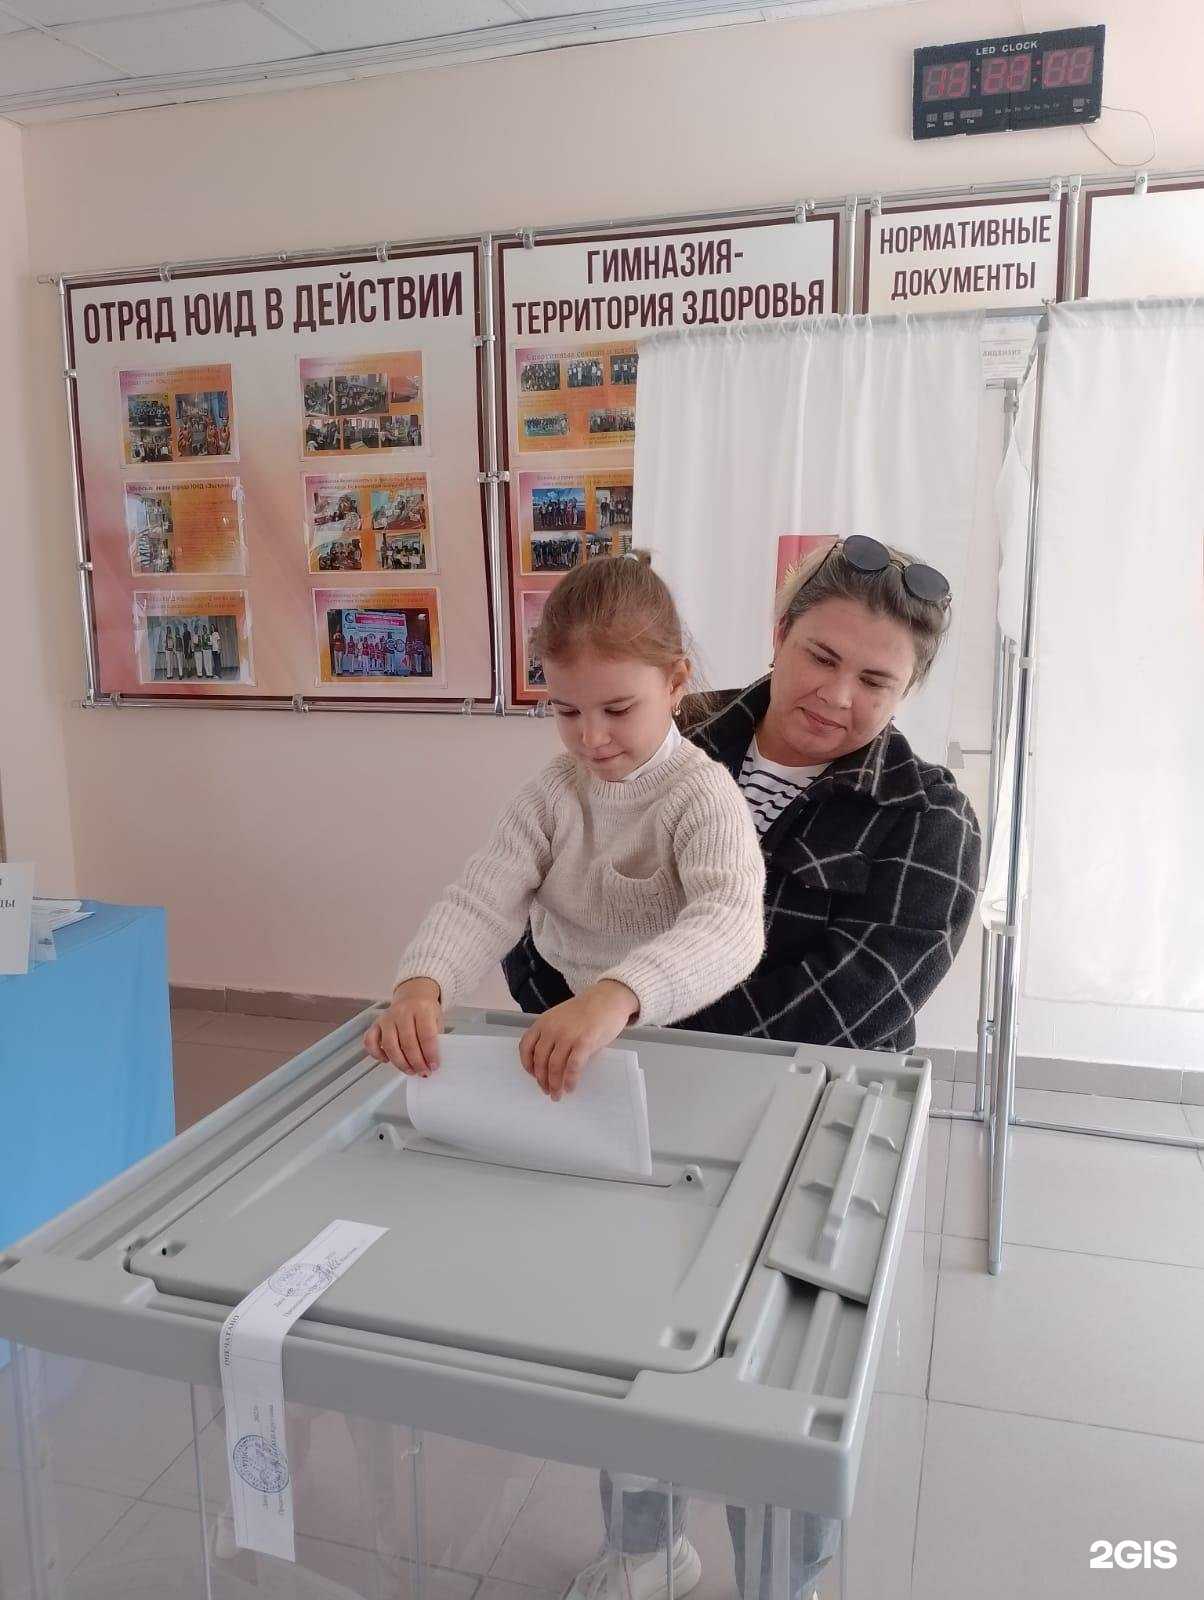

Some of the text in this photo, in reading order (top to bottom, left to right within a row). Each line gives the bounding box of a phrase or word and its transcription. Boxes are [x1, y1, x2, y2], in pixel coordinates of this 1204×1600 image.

[976, 40, 1038, 56] LED CLOCK
[880, 215, 1052, 254] НОРМАТИВНЫЕ
[587, 238, 744, 284] ГИМНАЗИЯ-
[891, 261, 1036, 301] ДОКУМЕНТЫ
[83, 271, 463, 344] ОТРЯД ЮИД В ДЕЙСТВИИ
[512, 279, 825, 335] ТЕРРИТОРИЯ ЗДОРОВЬЯ
